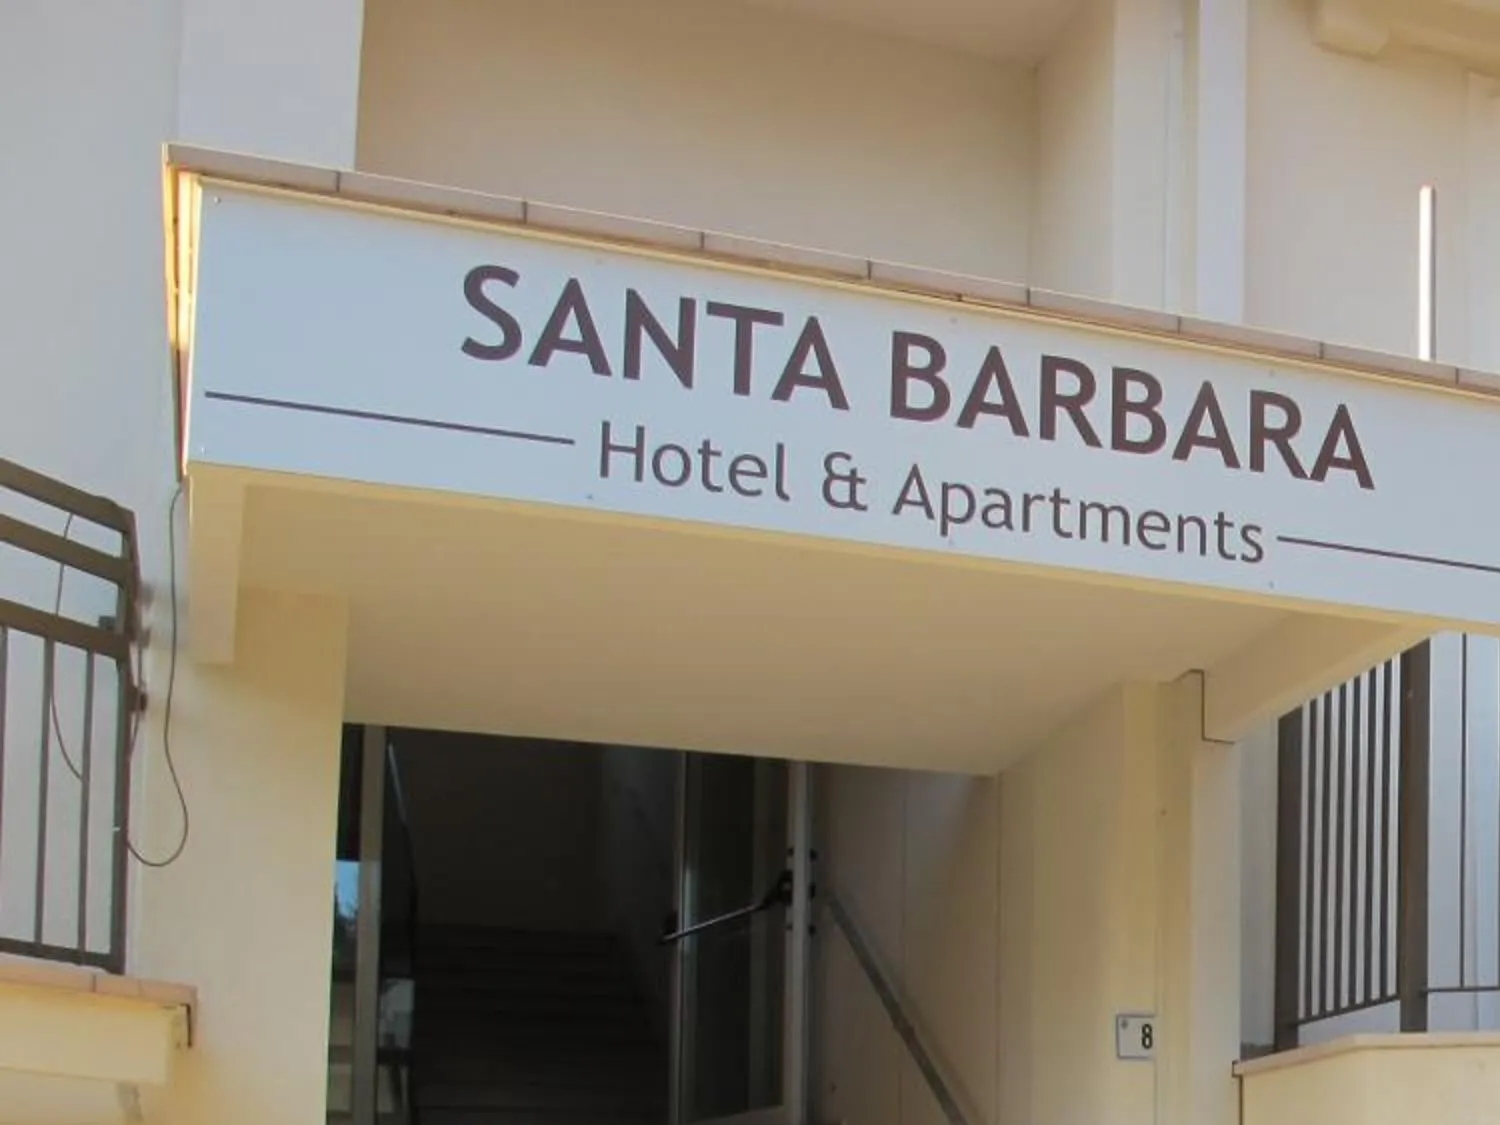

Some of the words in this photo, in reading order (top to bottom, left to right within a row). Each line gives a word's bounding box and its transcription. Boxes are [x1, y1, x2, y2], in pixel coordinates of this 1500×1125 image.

[460, 263, 851, 411] SANTA
[889, 329, 1375, 491] BARBARA
[599, 419, 792, 503] Hotel
[821, 451, 869, 512] &
[892, 462, 1265, 563] Apartments
[1141, 1023, 1153, 1050] 8
